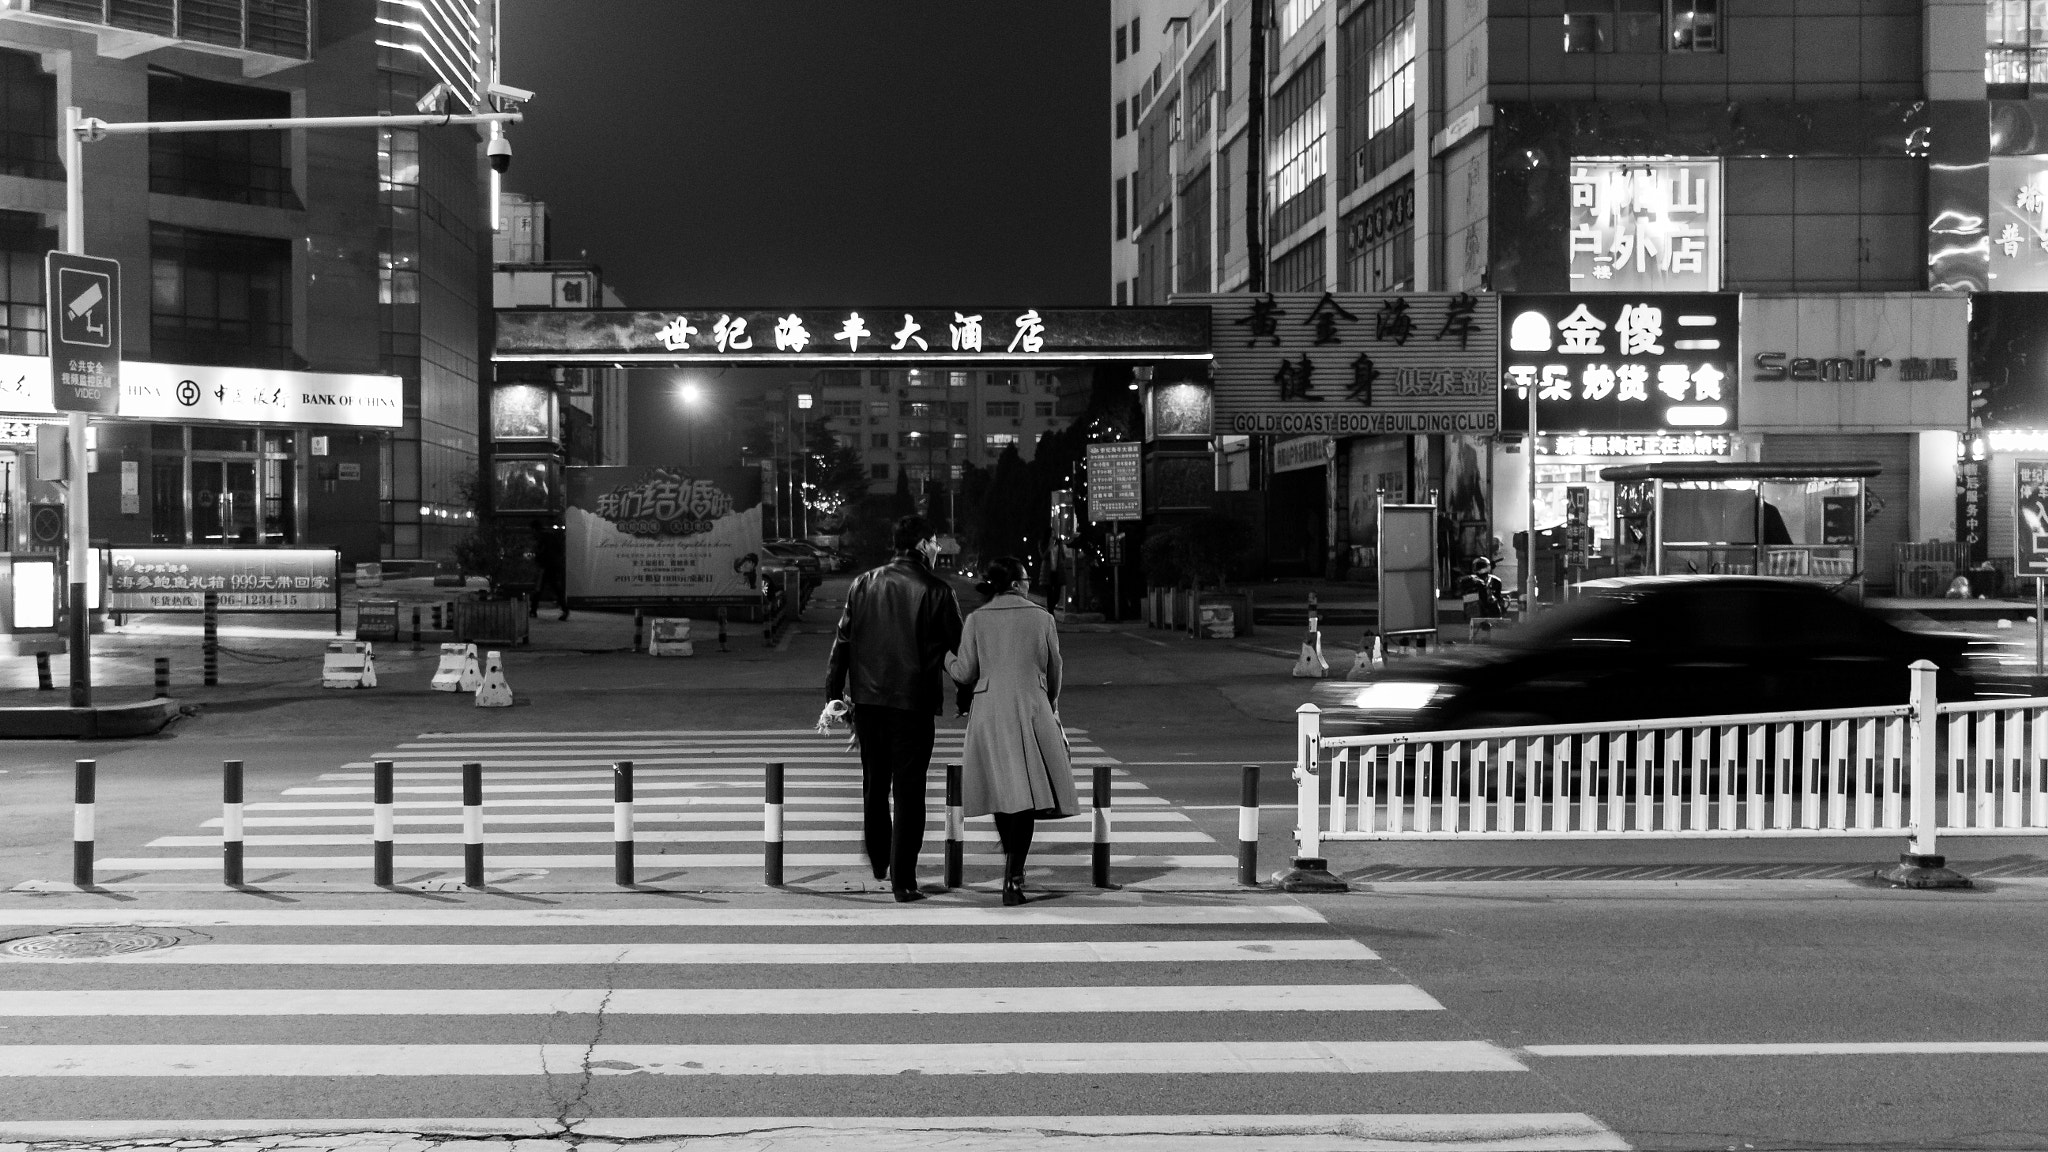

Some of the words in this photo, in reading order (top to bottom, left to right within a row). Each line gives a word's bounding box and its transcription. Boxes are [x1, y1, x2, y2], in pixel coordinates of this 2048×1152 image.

[655, 310, 1046, 354] 世纪海丰大酒店
[1234, 292, 1482, 351] 黄金海岸
[1557, 303, 1721, 356] 金傻二
[68, 360, 104, 374] 公共安全
[1274, 352, 1382, 408] 健身
[1395, 367, 1490, 397] 俱乐部
[1582, 363, 1649, 402] 炒货
[1657, 363, 1725, 401] 零食
[1754, 349, 1893, 382] Semir
[74, 388, 101, 399] VIDEO
[302, 393, 337, 406] BANK
[1235, 413, 1277, 431] GOLD
[1282, 413, 1334, 431] COAST
[1340, 413, 1380, 431] BODY
[1386, 413, 1450, 431] BUILDING
[1457, 412, 1497, 431] CLUB
